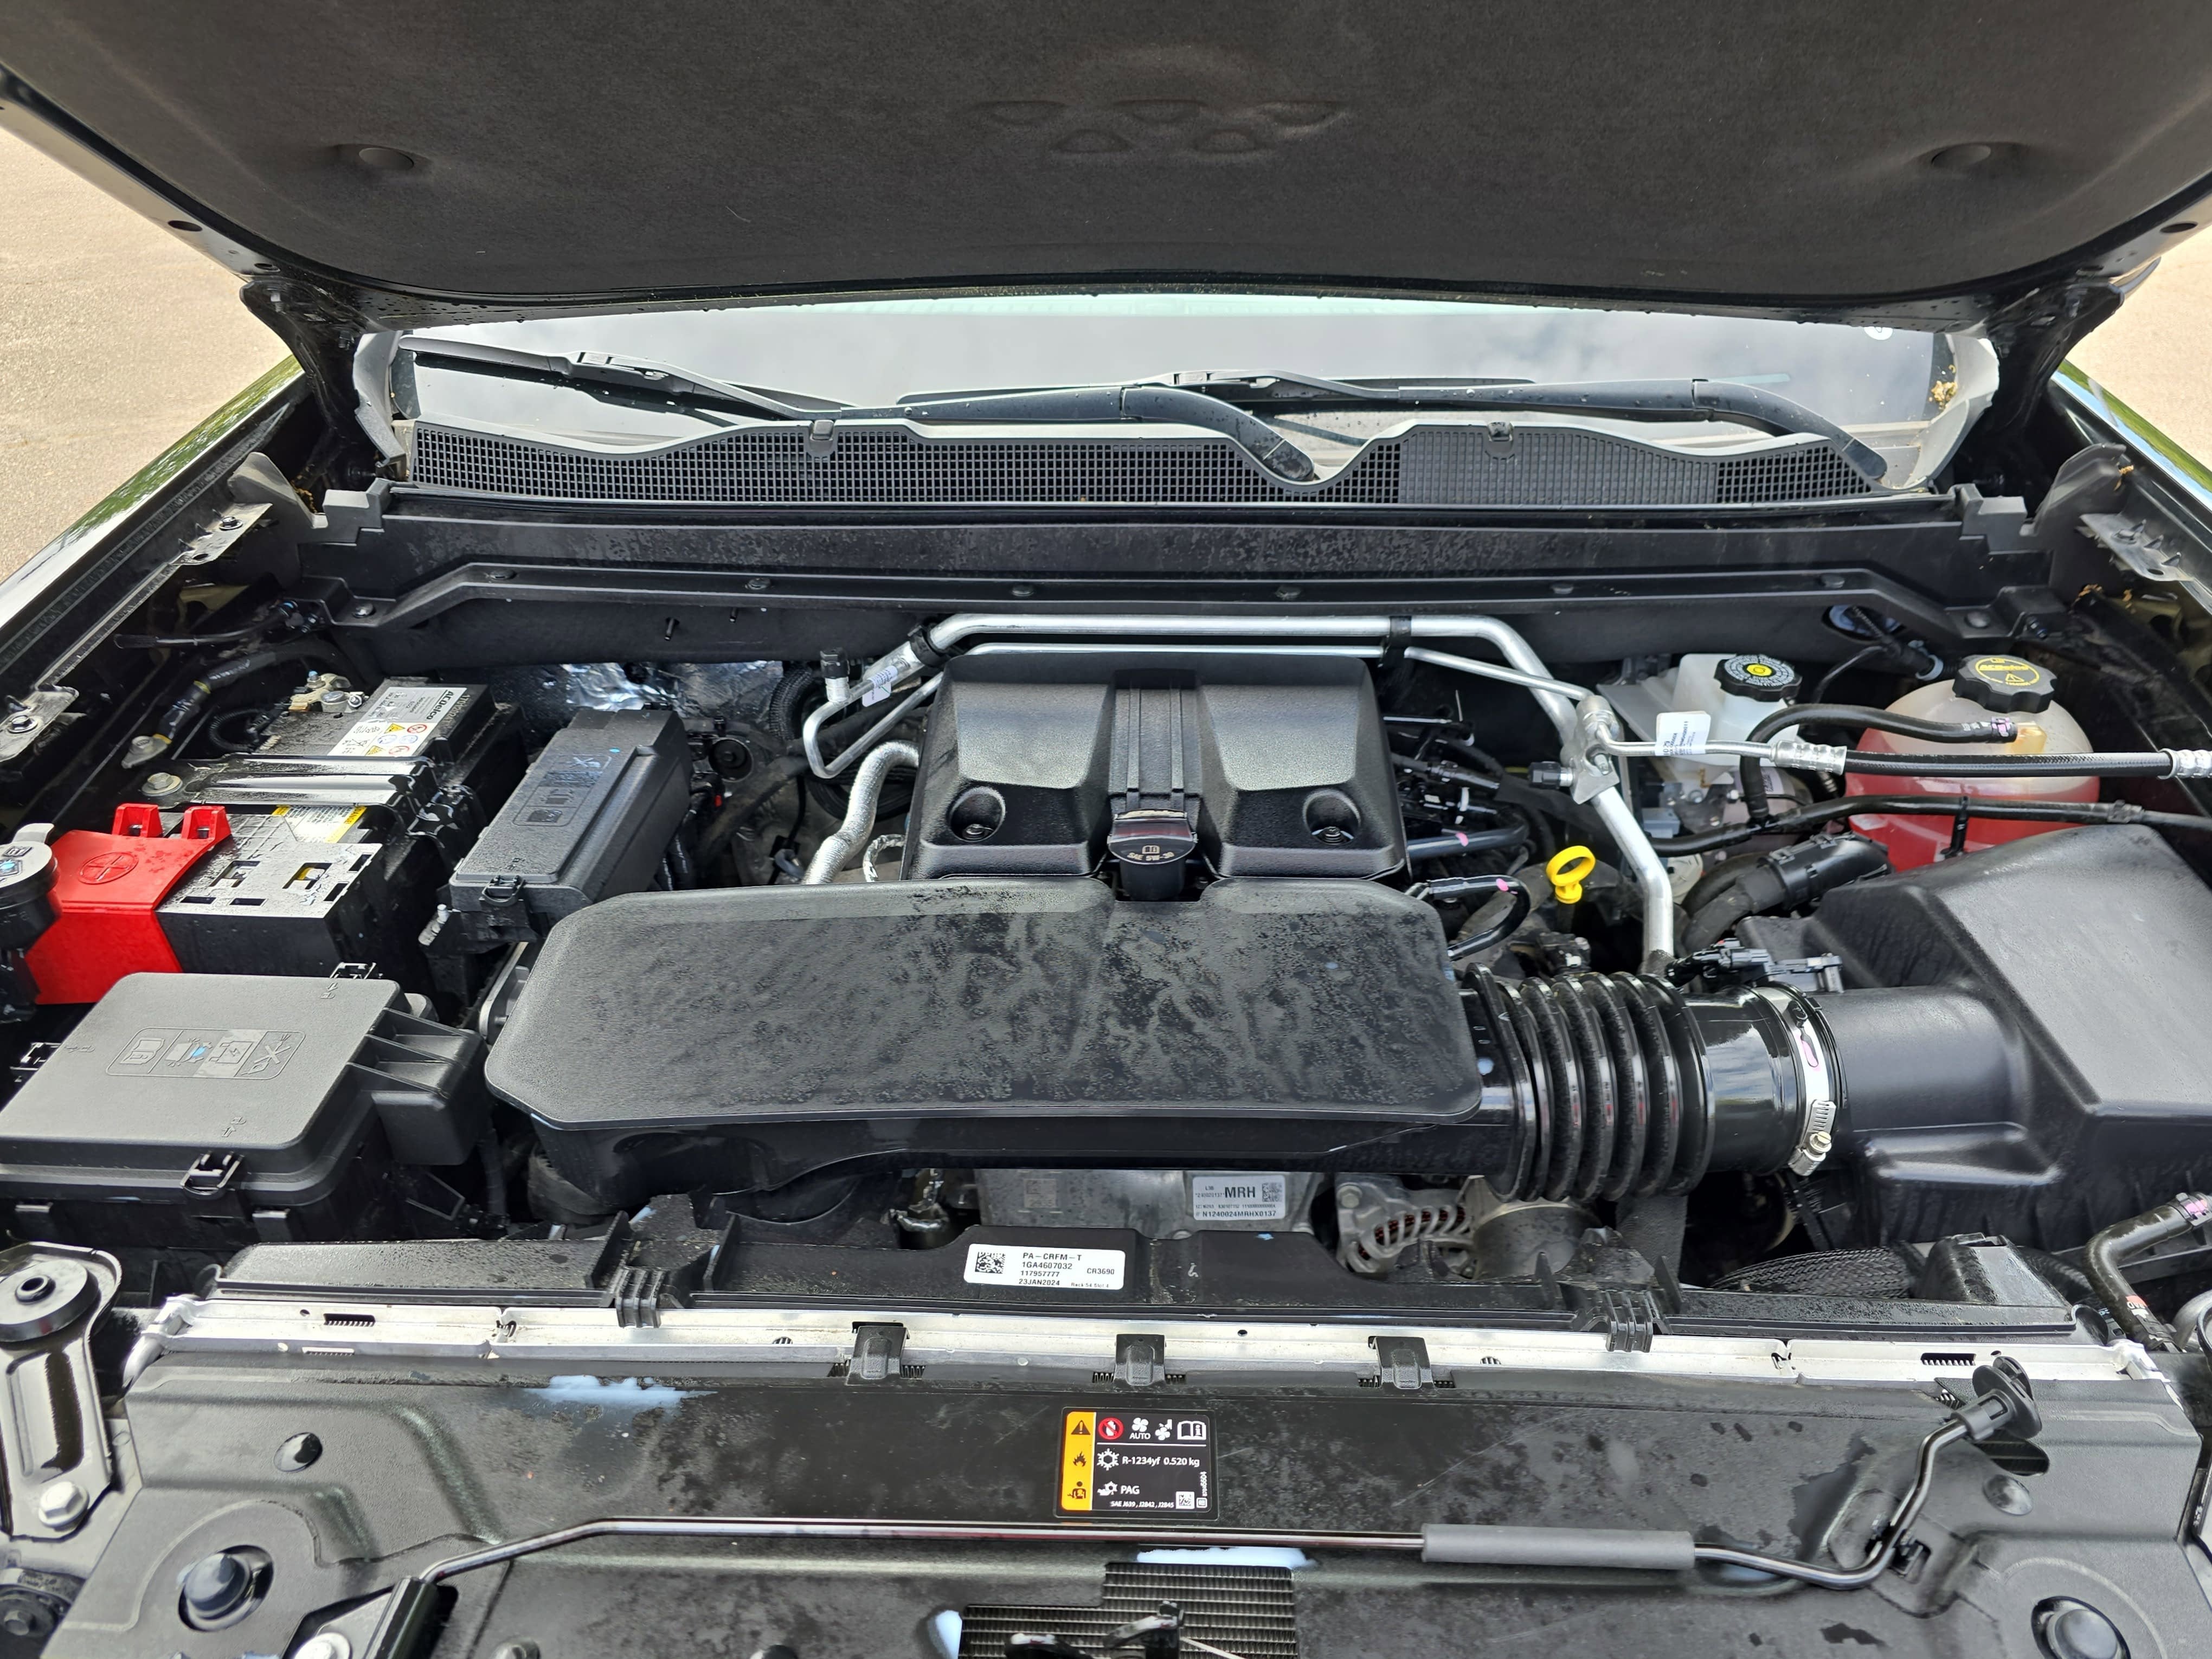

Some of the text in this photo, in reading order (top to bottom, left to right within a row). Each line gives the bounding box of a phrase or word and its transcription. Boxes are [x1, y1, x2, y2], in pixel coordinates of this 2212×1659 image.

[426, 690, 454, 720] ACDelco
[1127, 852, 1175, 861] SAE 5W-30
[1225, 1186, 1256, 1199] MRH
[1022, 1262, 1072, 1270] 1GA4607032
[1086, 1268, 1115, 1276] CR3690
[1018, 1278, 1060, 1287] 23JAN2024
[1122, 1457, 1200, 1467] R-1234yf 0.520 kg
[1121, 1486, 1140, 1495] PAG
